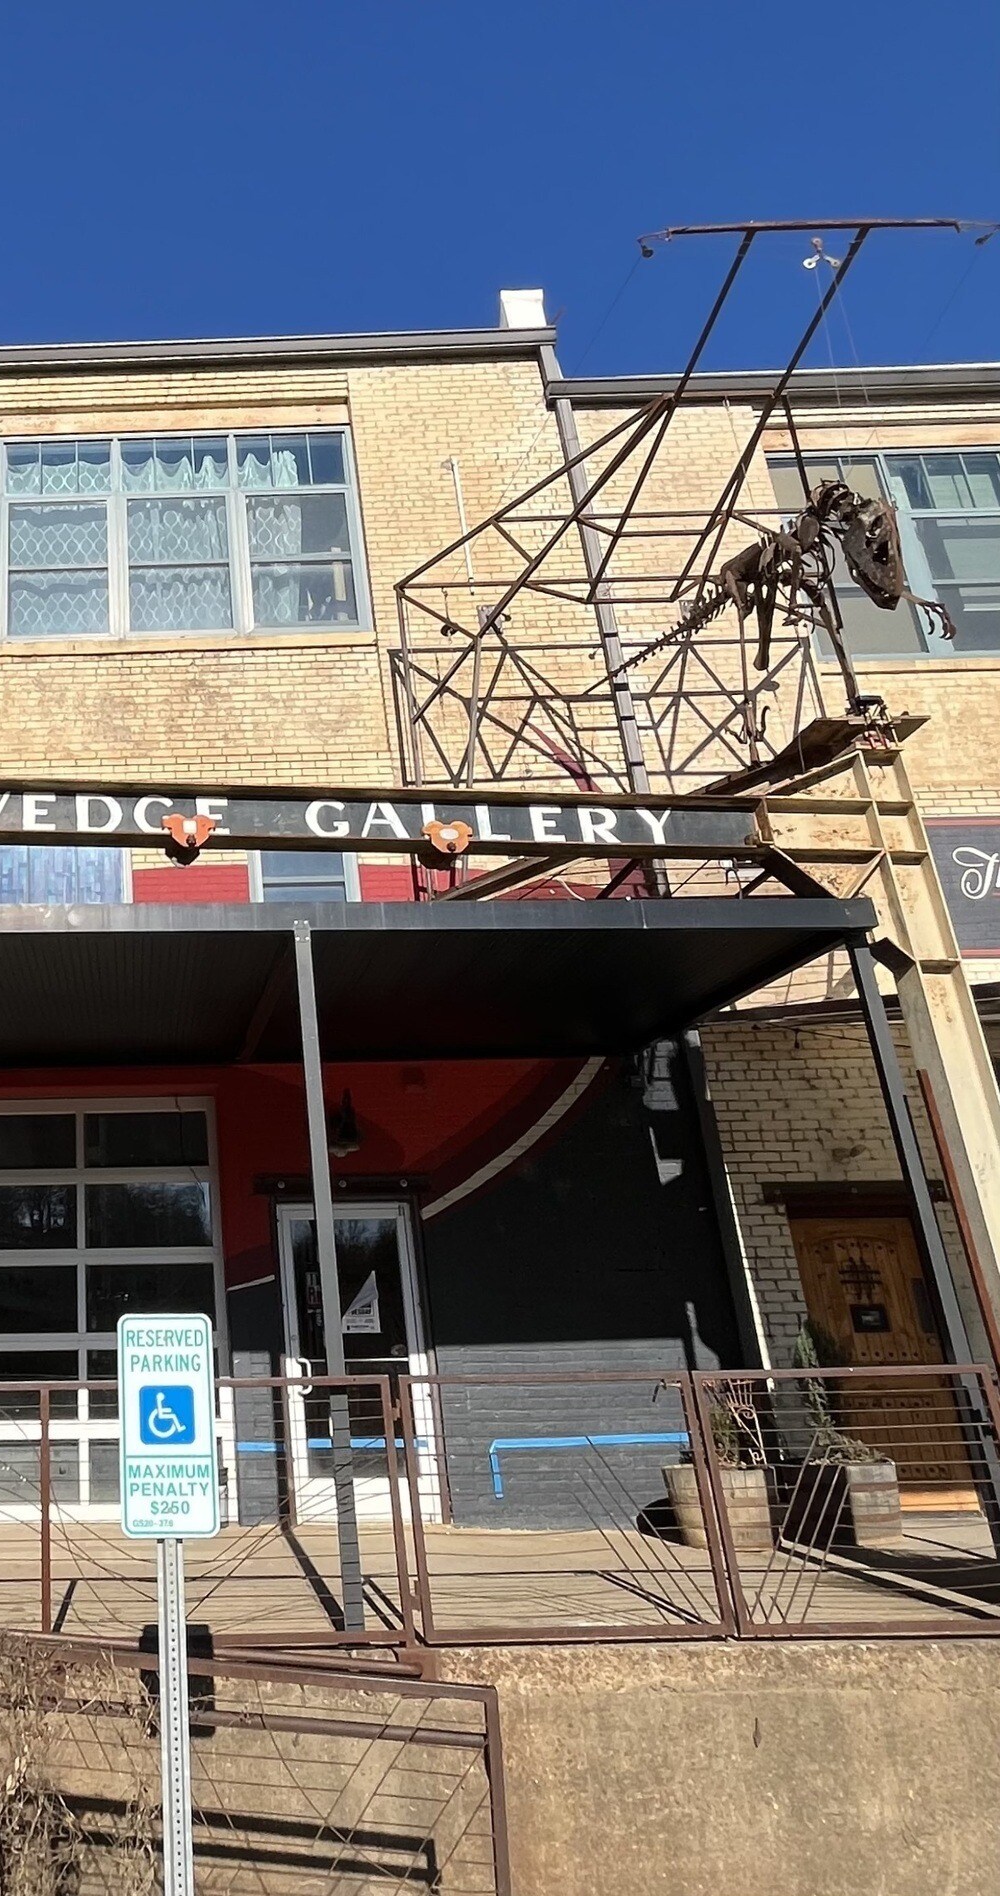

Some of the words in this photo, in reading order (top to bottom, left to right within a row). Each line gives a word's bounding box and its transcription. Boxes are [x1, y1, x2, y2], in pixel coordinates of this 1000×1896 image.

[126, 1329, 204, 1348] RESERVED
[130, 1354, 201, 1373] PARKING
[128, 1464, 210, 1479] MAXIMUM
[129, 1482, 210, 1497] PENALTY
[150, 1500, 190, 1515] $250
